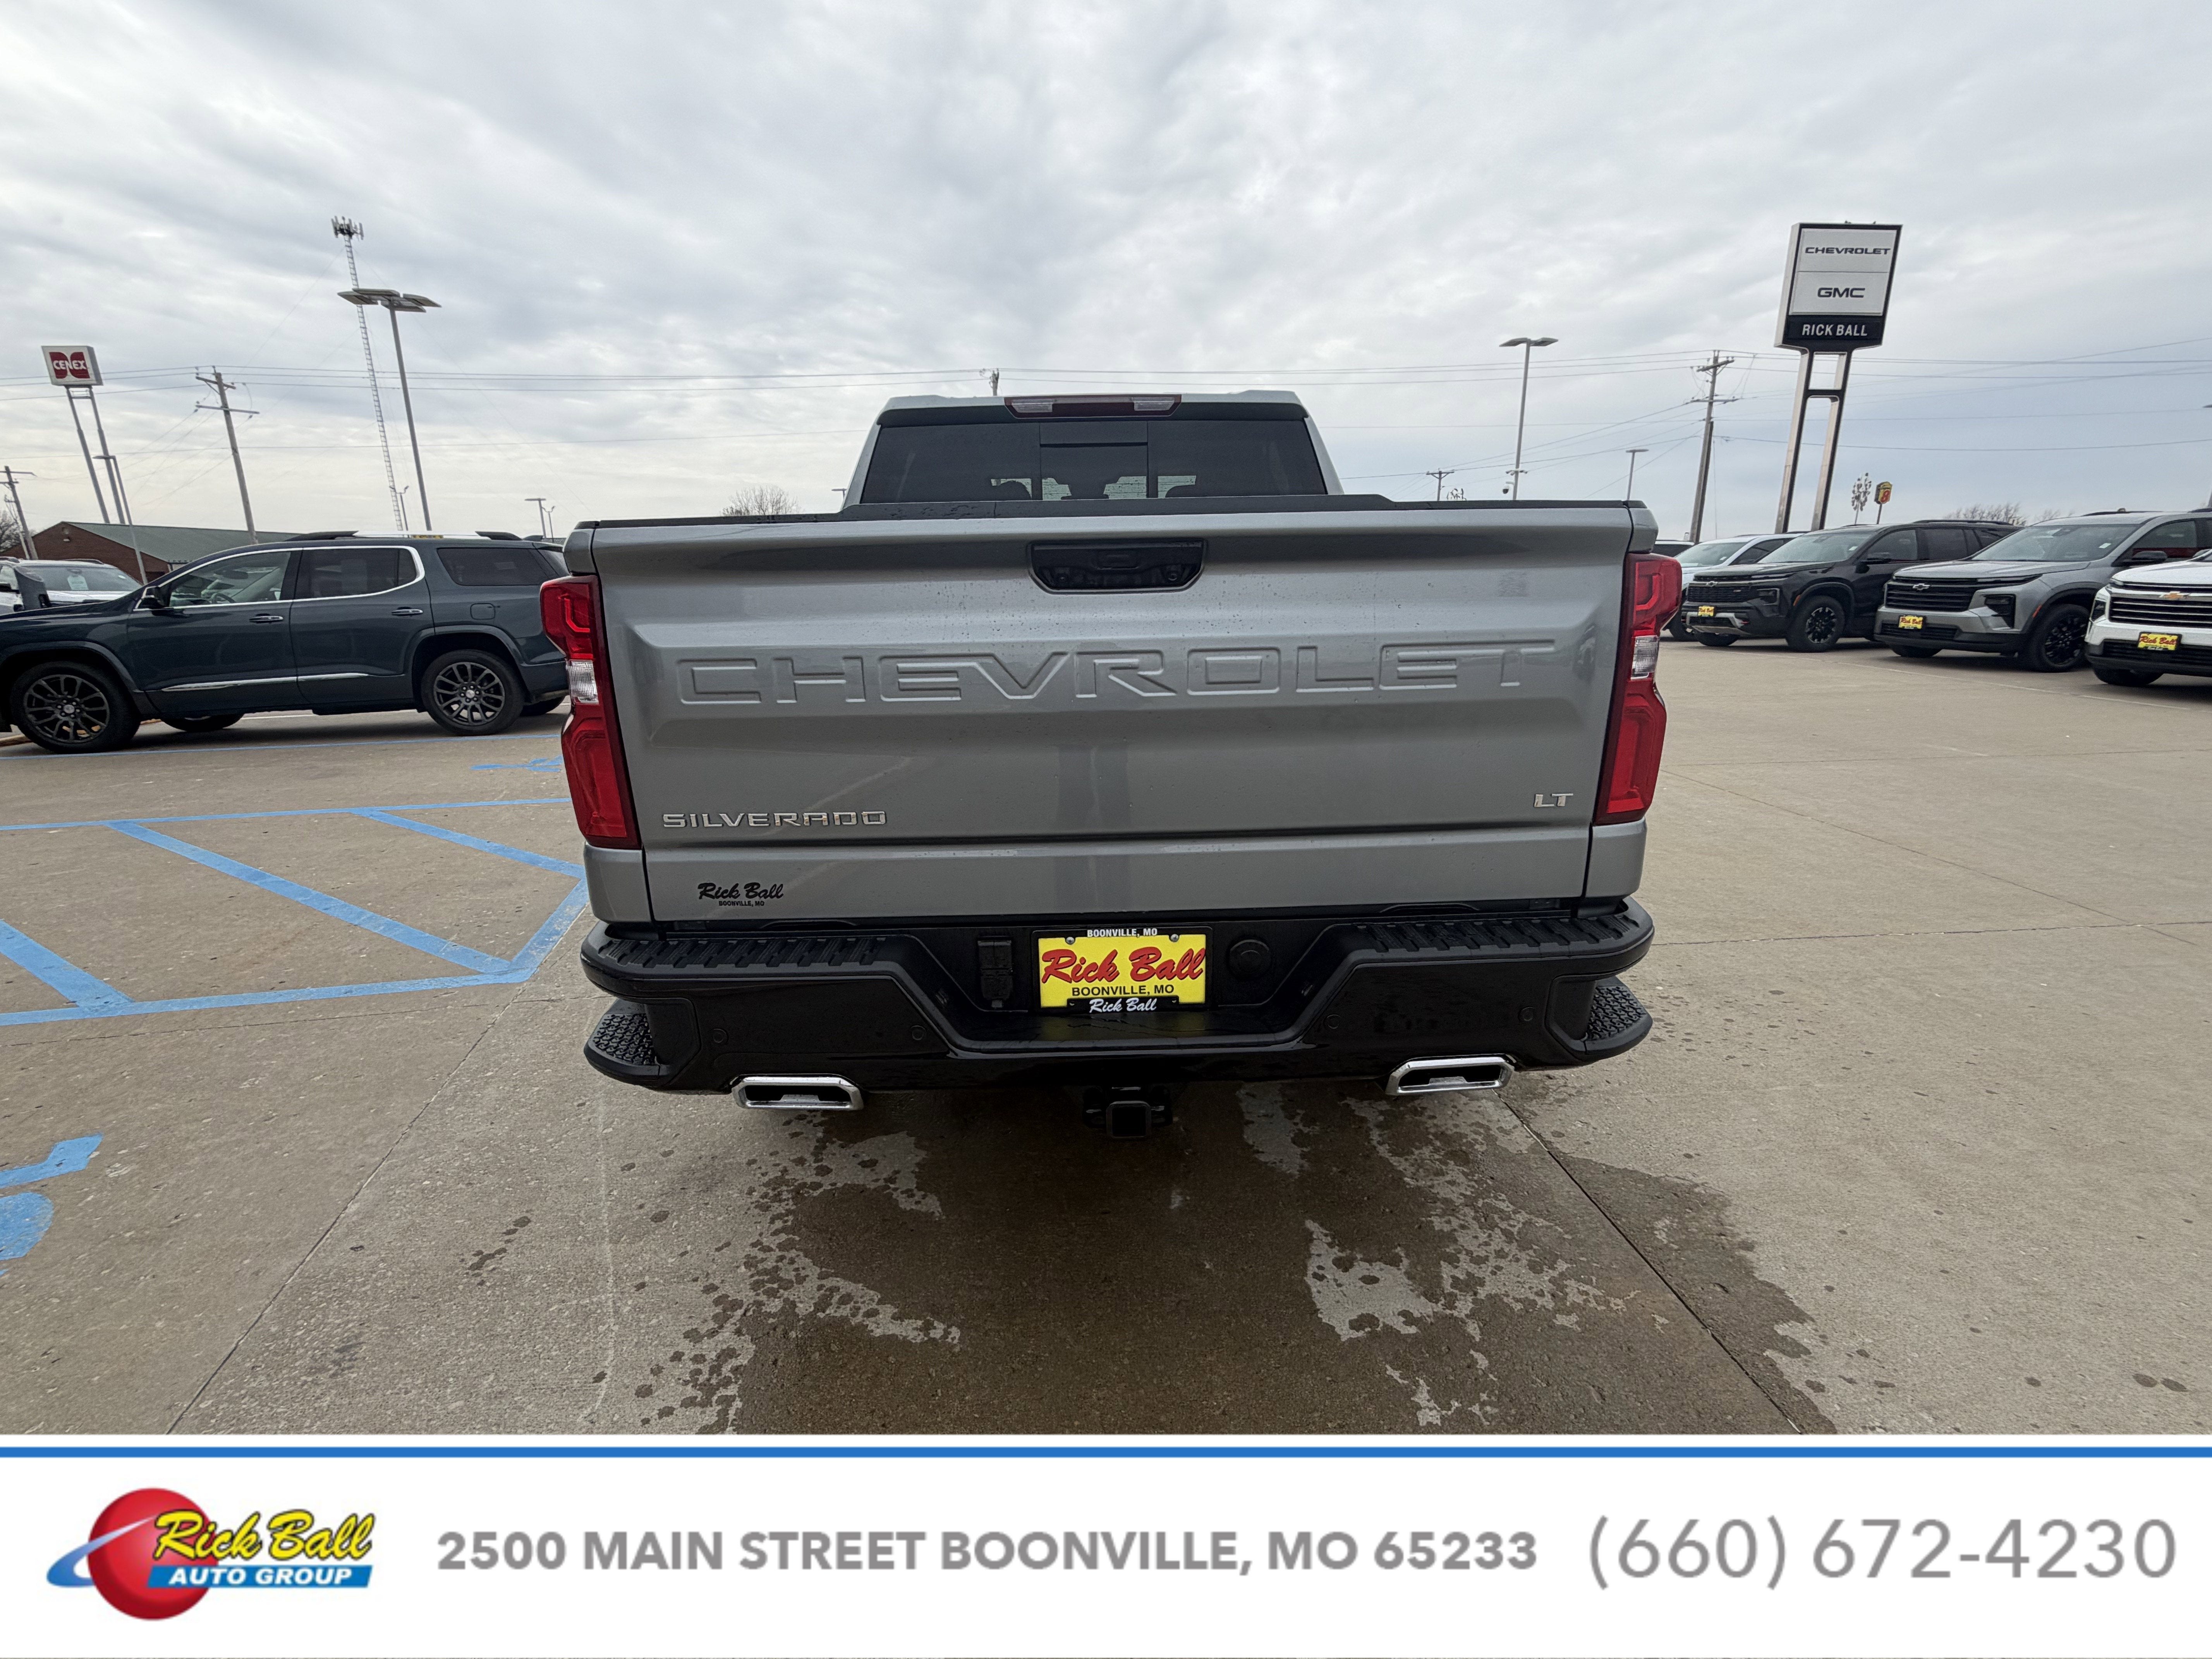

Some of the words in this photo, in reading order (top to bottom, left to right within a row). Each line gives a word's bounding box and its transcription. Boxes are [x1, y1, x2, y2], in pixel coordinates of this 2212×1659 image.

[1817, 288, 1865, 298] GMC
[1802, 324, 1835, 336] RICK
[1836, 325, 1868, 336] BALL
[53, 360, 87, 370] CENEX
[677, 639, 1555, 704] CHEVROLET
[1534, 793, 1574, 807] LT
[663, 811, 887, 828] SILVERADO
[697, 883, 740, 899] Rick
[744, 882, 784, 899] Ball
[1087, 929, 1140, 938] BOONVILLE,
[1042, 949, 1120, 984] Rick
[1128, 946, 1206, 982] Ball
[1072, 985, 1150, 996] BOONVILLE,
[1154, 984, 1174, 994] MO
[1089, 998, 1123, 1013] Rick
[1126, 998, 1157, 1012] Ball
